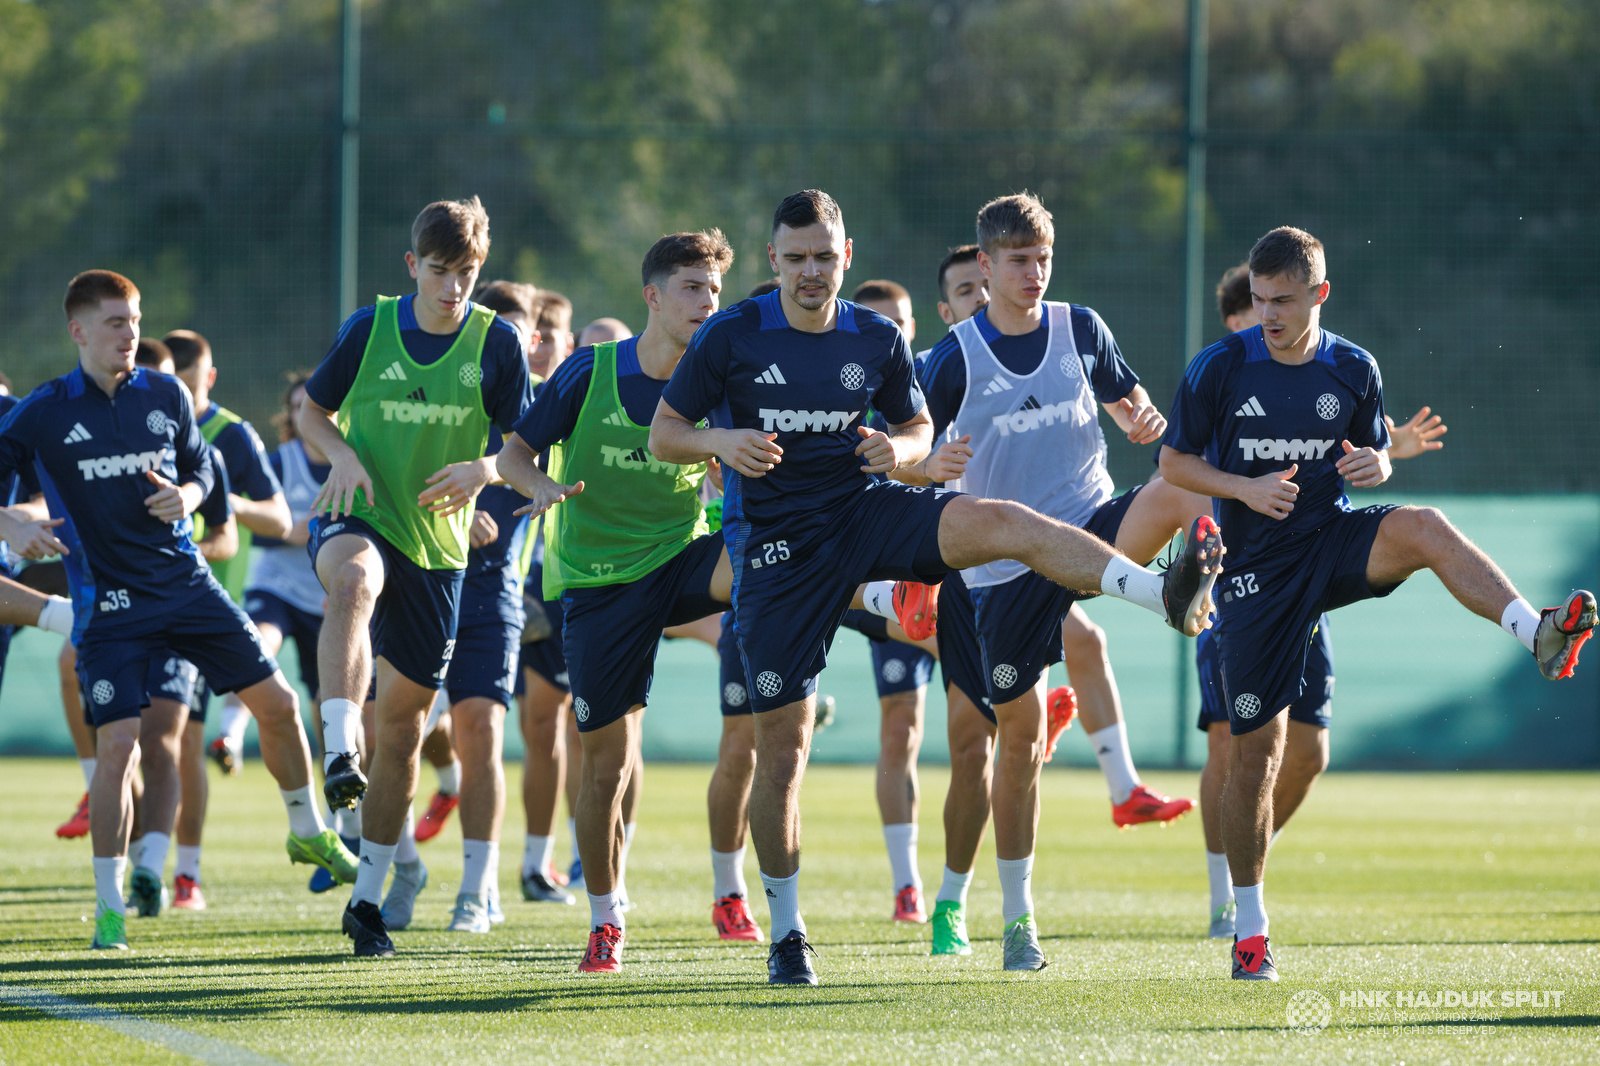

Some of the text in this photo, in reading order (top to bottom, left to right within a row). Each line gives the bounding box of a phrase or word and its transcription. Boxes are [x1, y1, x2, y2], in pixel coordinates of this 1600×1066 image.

[380, 400, 474, 426] TOMMY
[759, 408, 861, 433] TOMMY
[992, 400, 1090, 437] TOMMY
[601, 445, 679, 477] TOMM
[1239, 438, 1334, 461] TOMMY
[78, 450, 167, 481] TOMMY
[763, 540, 791, 565] 25
[1231, 573, 1259, 598] 32
[106, 589, 132, 611] 35
